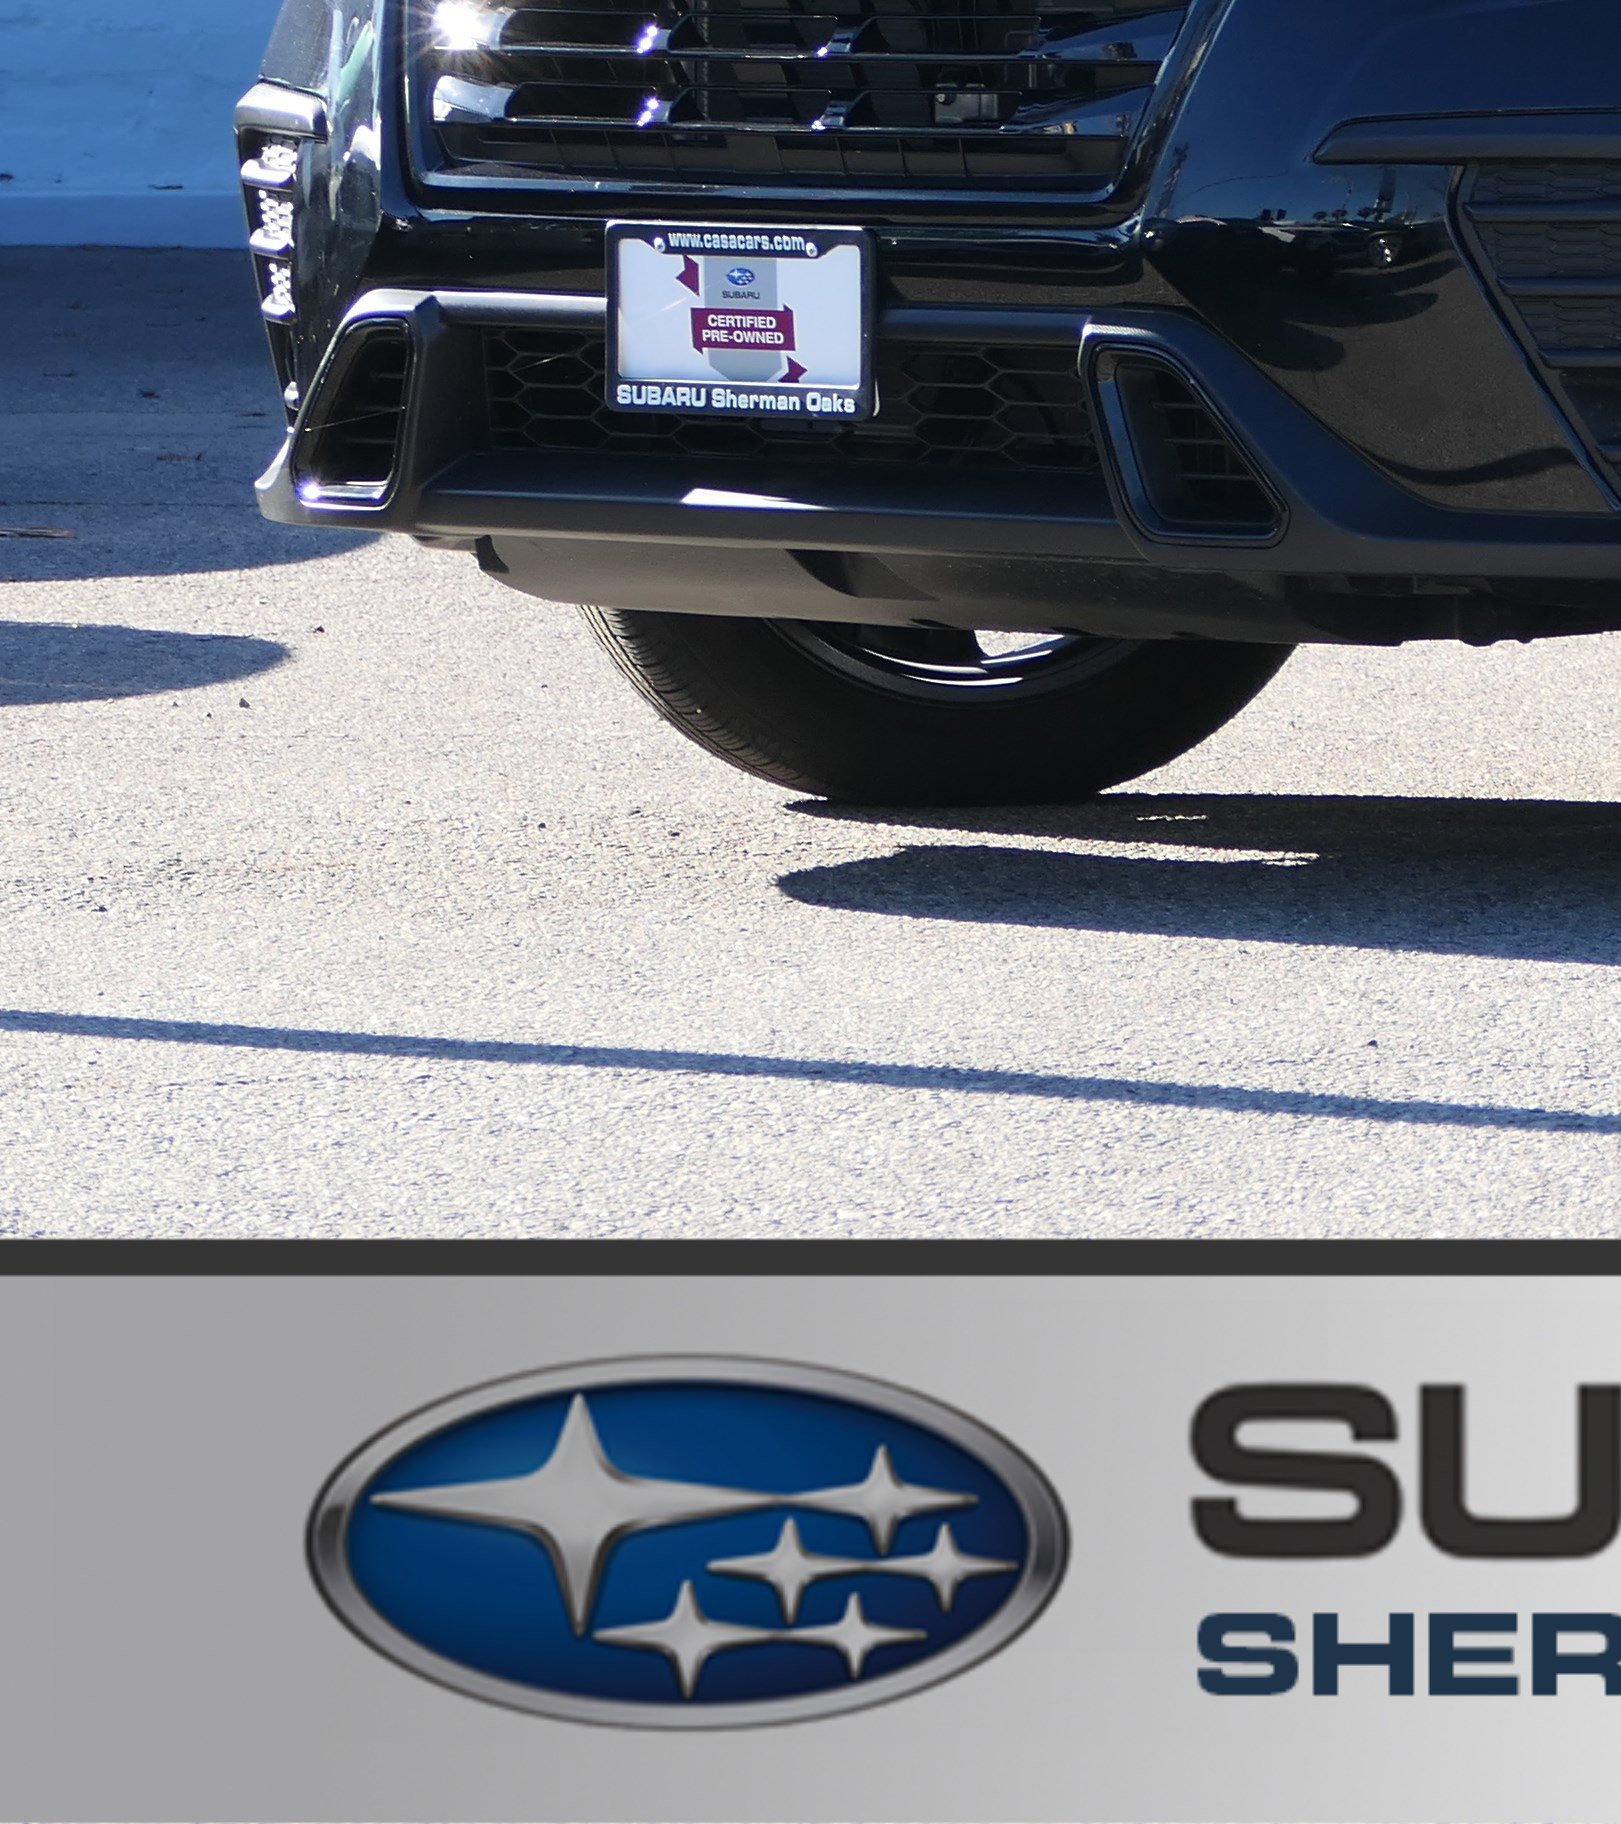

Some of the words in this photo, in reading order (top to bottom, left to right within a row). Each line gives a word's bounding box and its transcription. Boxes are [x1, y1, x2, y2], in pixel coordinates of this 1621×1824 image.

[667, 232, 805, 252] www.casacars.com
[721, 290, 761, 301] SUBARU
[707, 314, 777, 330] CERTIFIED
[702, 329, 784, 345] PRE-OWNED
[616, 384, 706, 408] SUBARU
[711, 388, 801, 411] Sherman
[806, 392, 856, 414] Oaks
